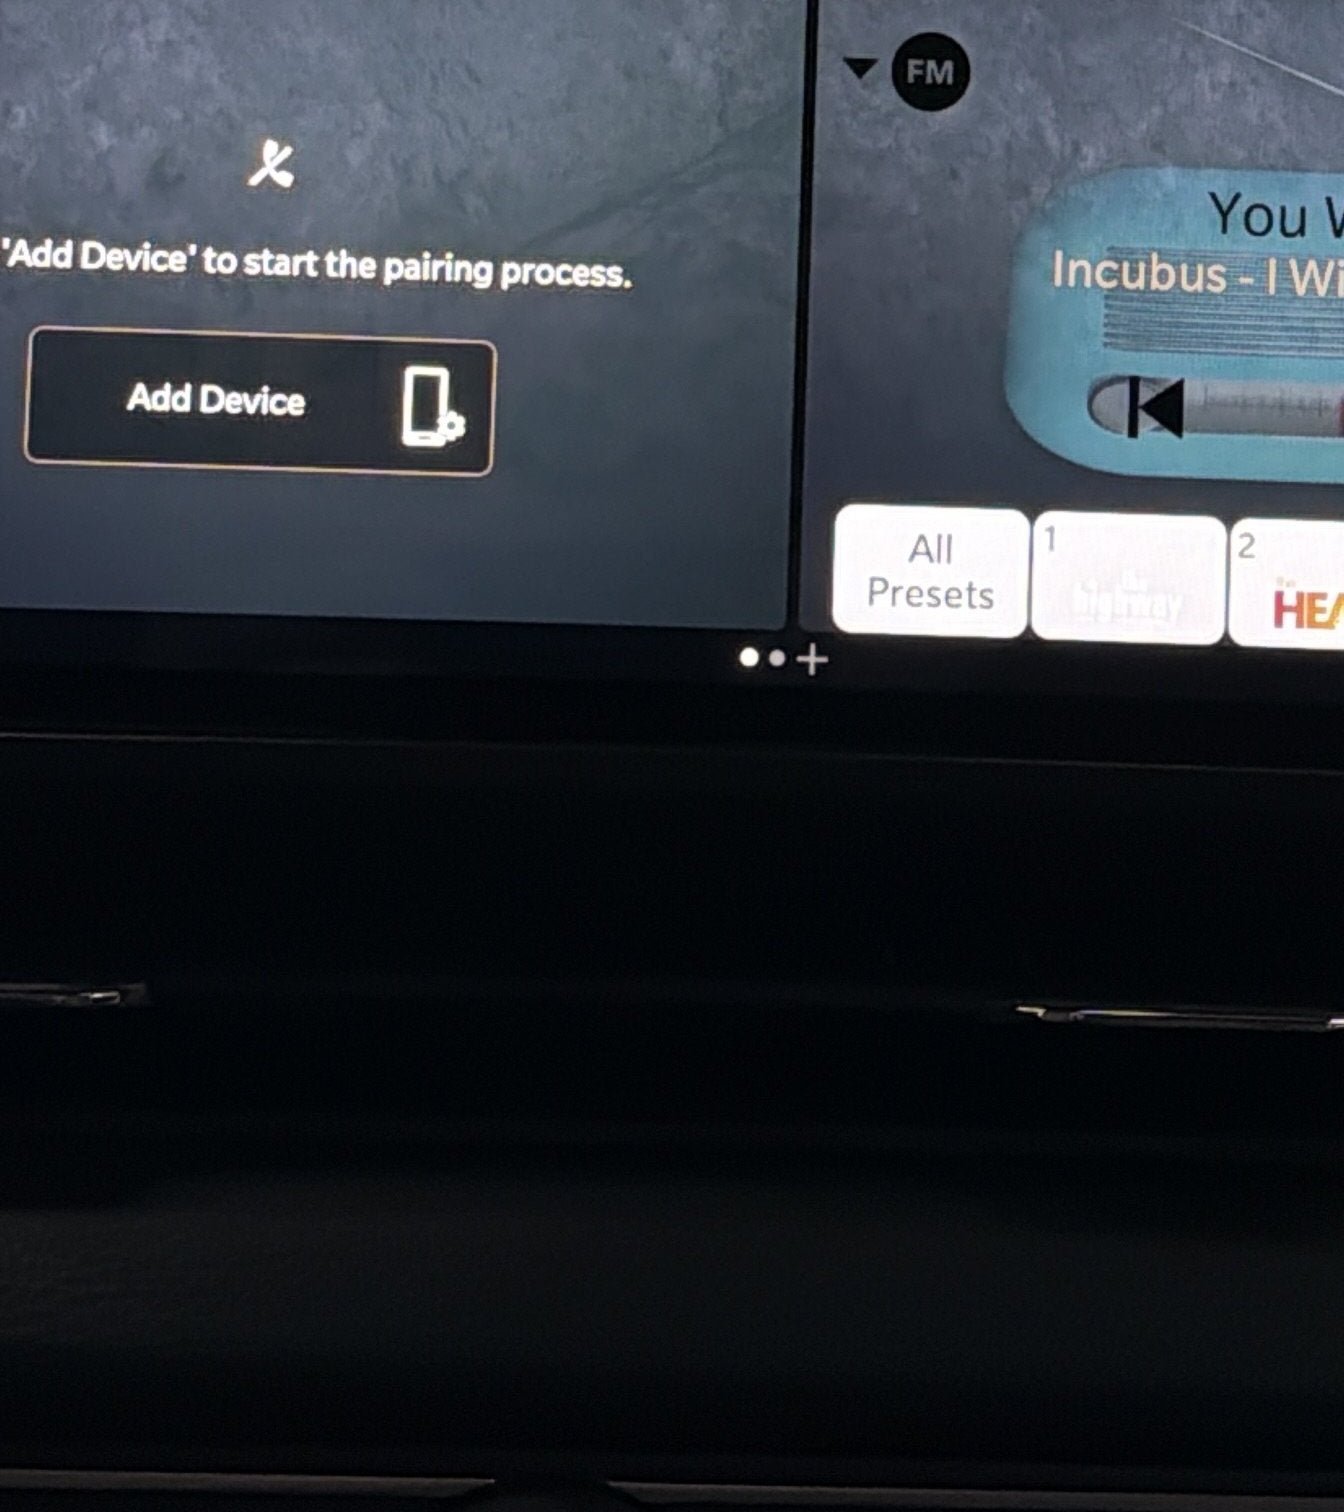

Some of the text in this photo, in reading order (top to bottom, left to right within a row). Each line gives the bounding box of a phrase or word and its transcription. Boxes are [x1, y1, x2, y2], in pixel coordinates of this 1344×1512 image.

[905, 57, 955, 88] FM
[1208, 191, 1308, 239] You
[202, 246, 238, 275] to
[242, 248, 318, 278] start
[324, 248, 378, 280] the
[383, 251, 494, 291] pairing
[501, 258, 634, 291] process.
[1054, 248, 1228, 294] Incubus
[126, 382, 307, 418] Add Device
[908, 533, 954, 565] All
[1045, 524, 1057, 553] 1
[1237, 531, 1256, 560] 2
[867, 576, 996, 611] Presets
